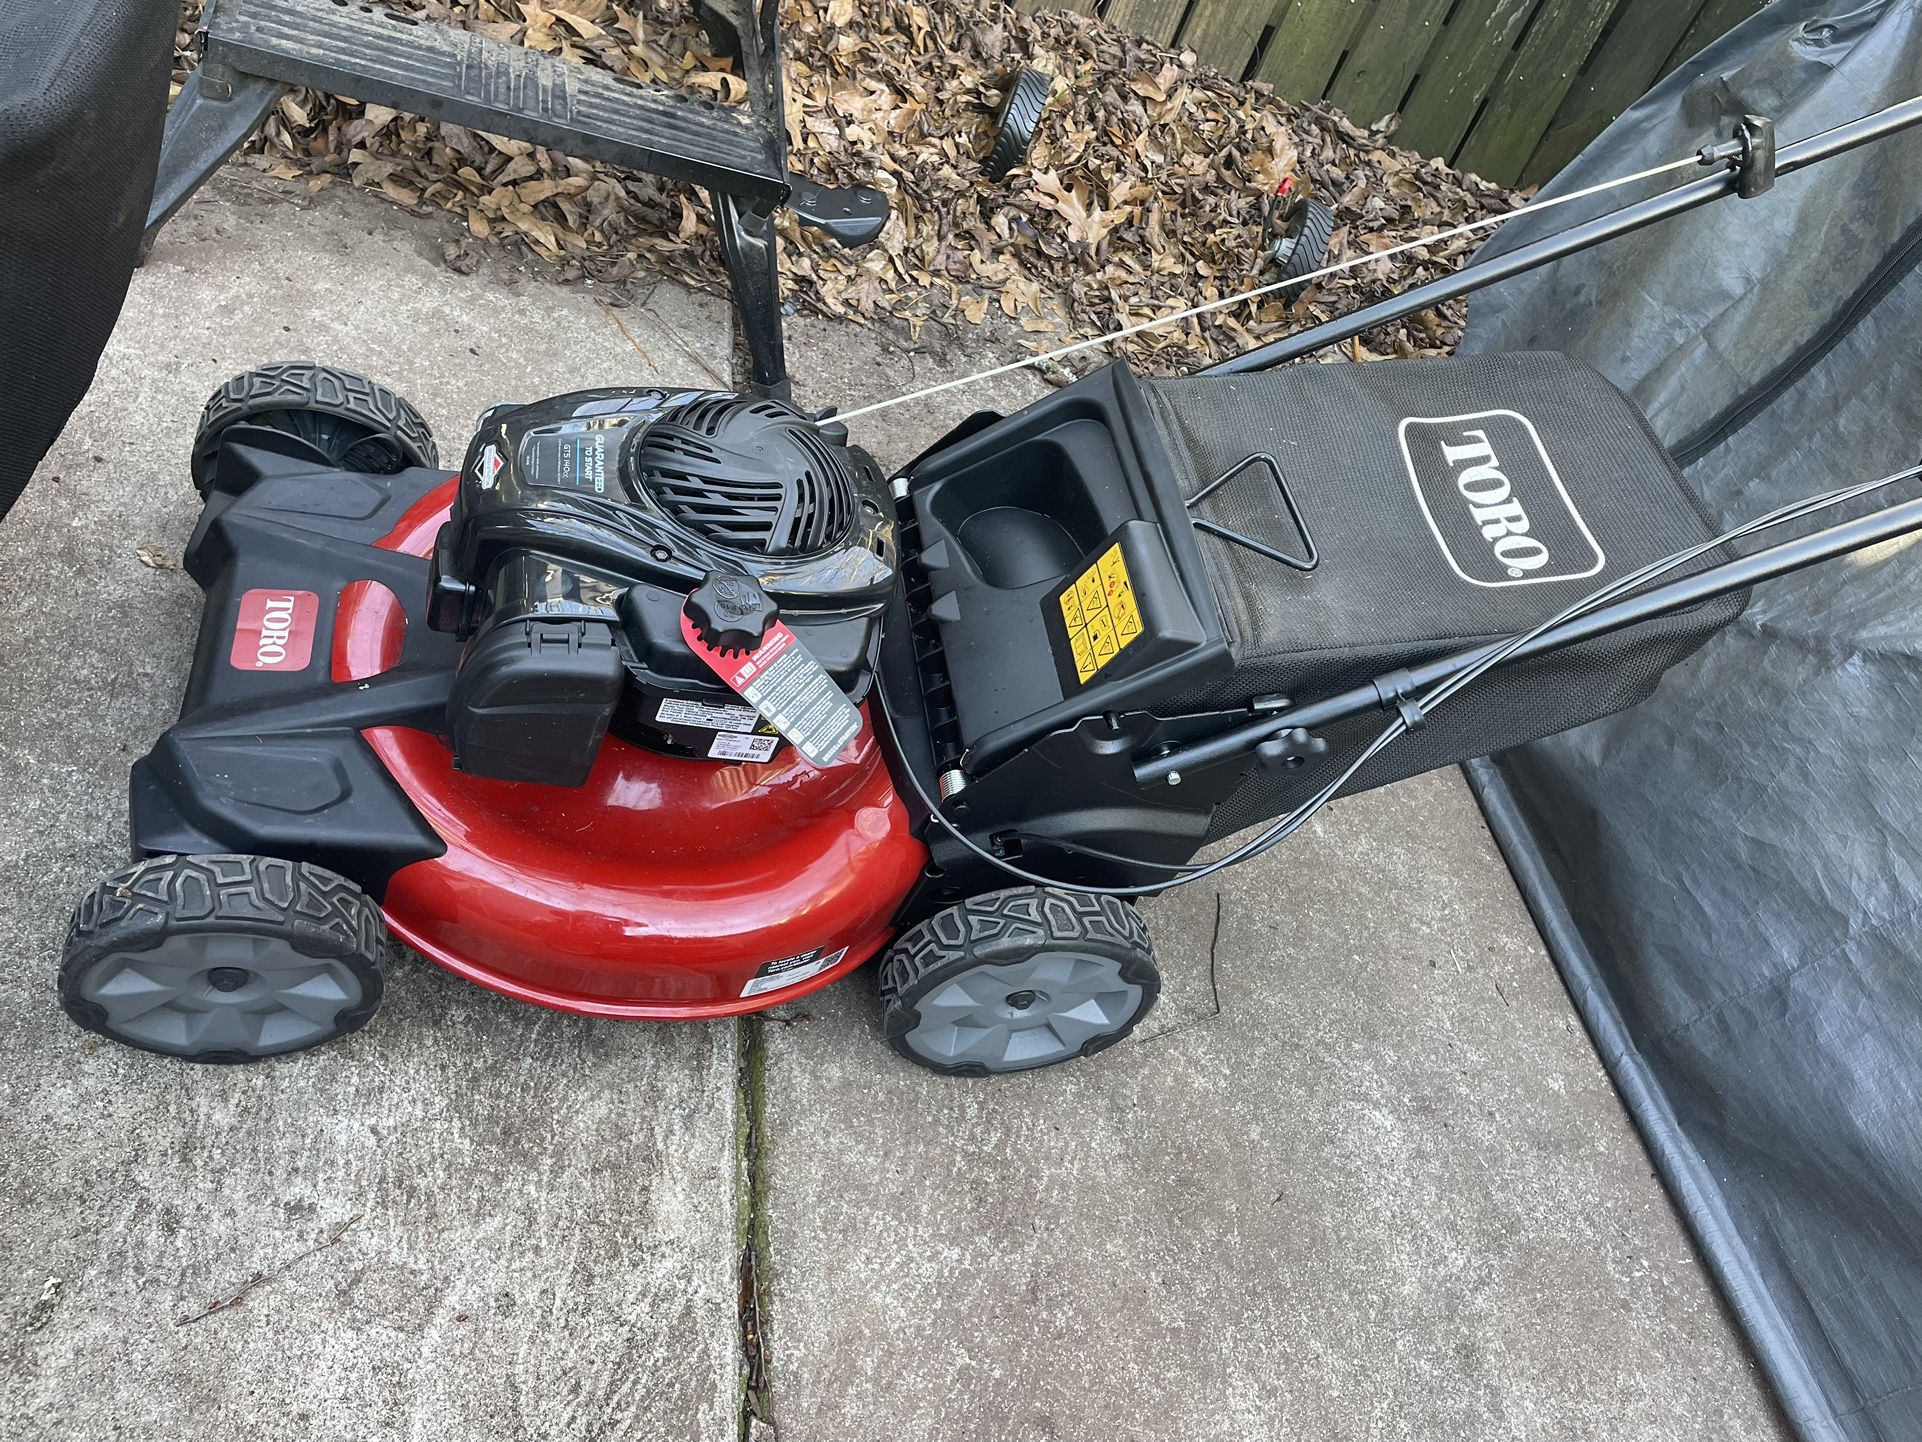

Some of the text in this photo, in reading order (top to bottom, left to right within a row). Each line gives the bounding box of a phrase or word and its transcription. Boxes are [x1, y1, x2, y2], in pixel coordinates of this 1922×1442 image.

[562, 459, 570, 478] 140cc
[584, 446, 593, 479] TO START
[595, 434, 604, 493] GUARANTEED
[1441, 429, 1549, 569] TORO
[256, 596, 294, 664] TORO
[751, 632, 784, 662] WARNING
